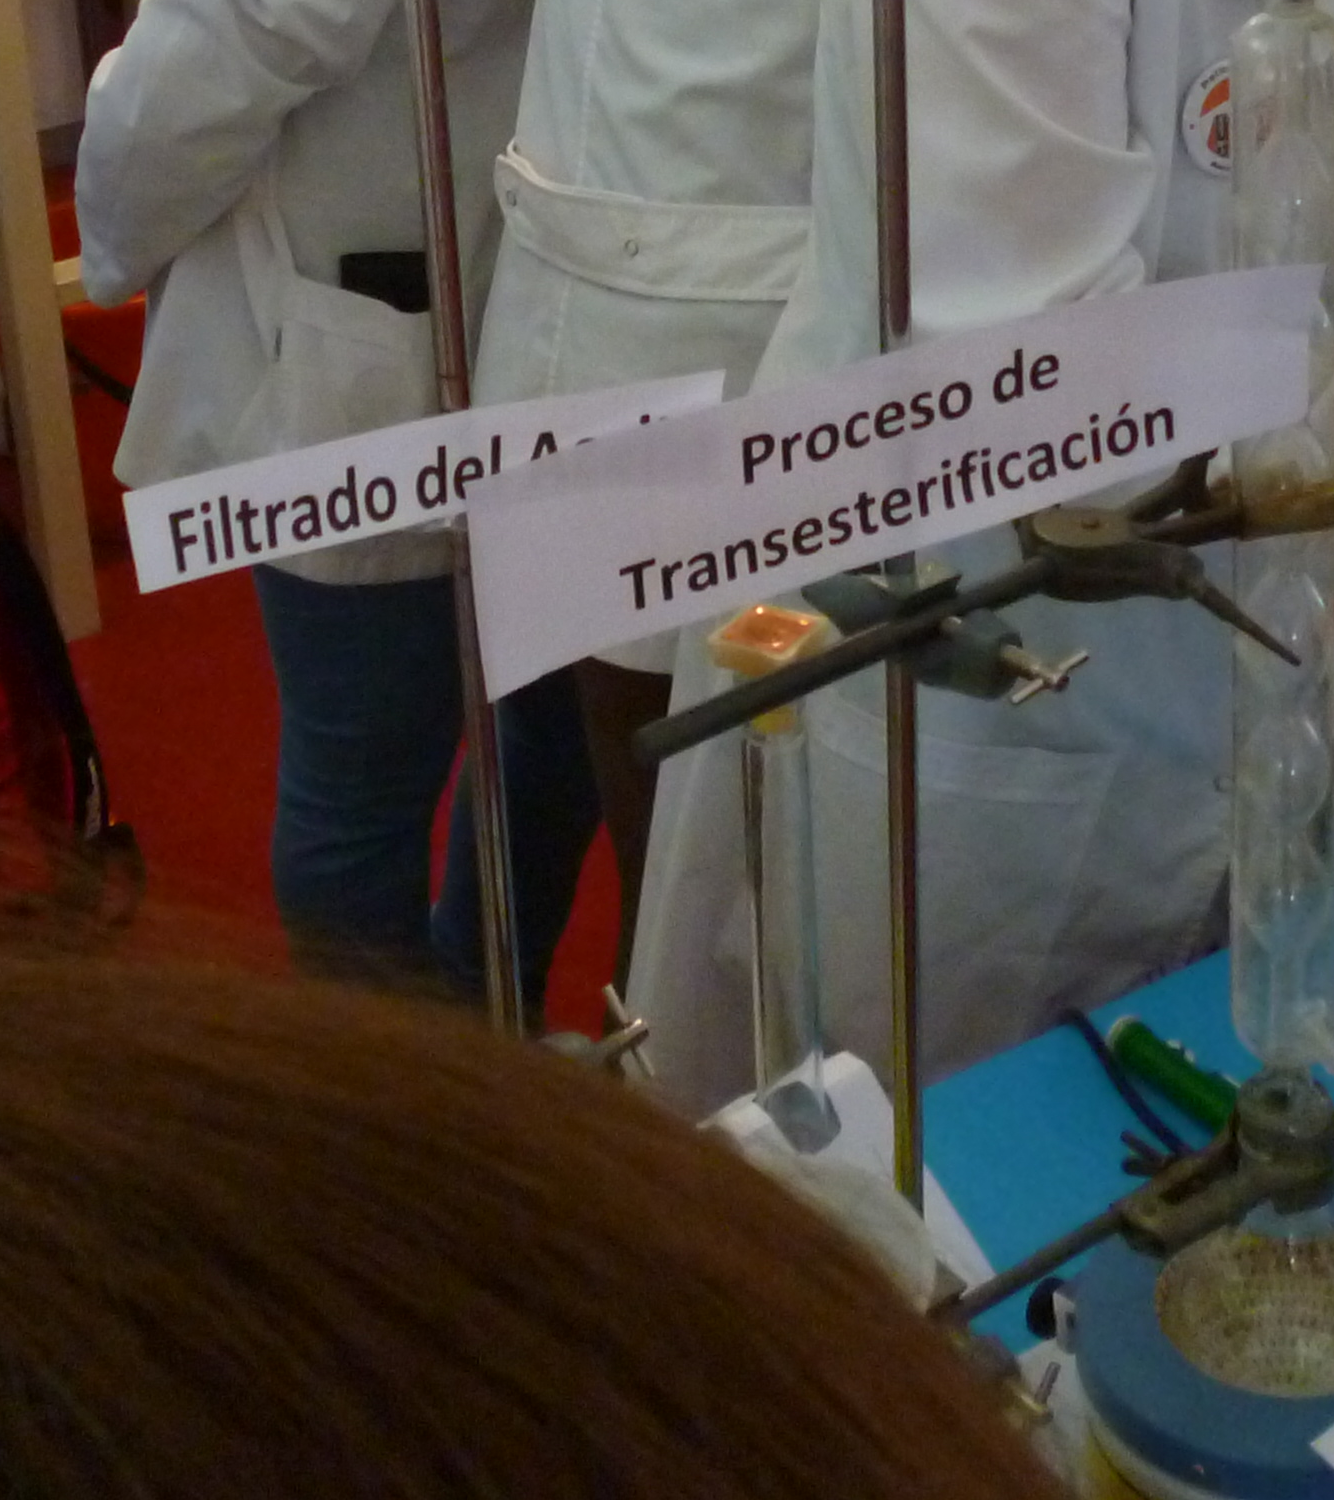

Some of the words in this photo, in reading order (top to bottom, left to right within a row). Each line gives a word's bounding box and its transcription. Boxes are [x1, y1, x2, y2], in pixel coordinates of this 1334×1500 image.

[741, 379, 973, 486] Proceso
[992, 348, 1061, 403] de
[168, 465, 397, 574] Filtrado
[416, 434, 503, 510] del
[619, 403, 1176, 611] Transesterificación
